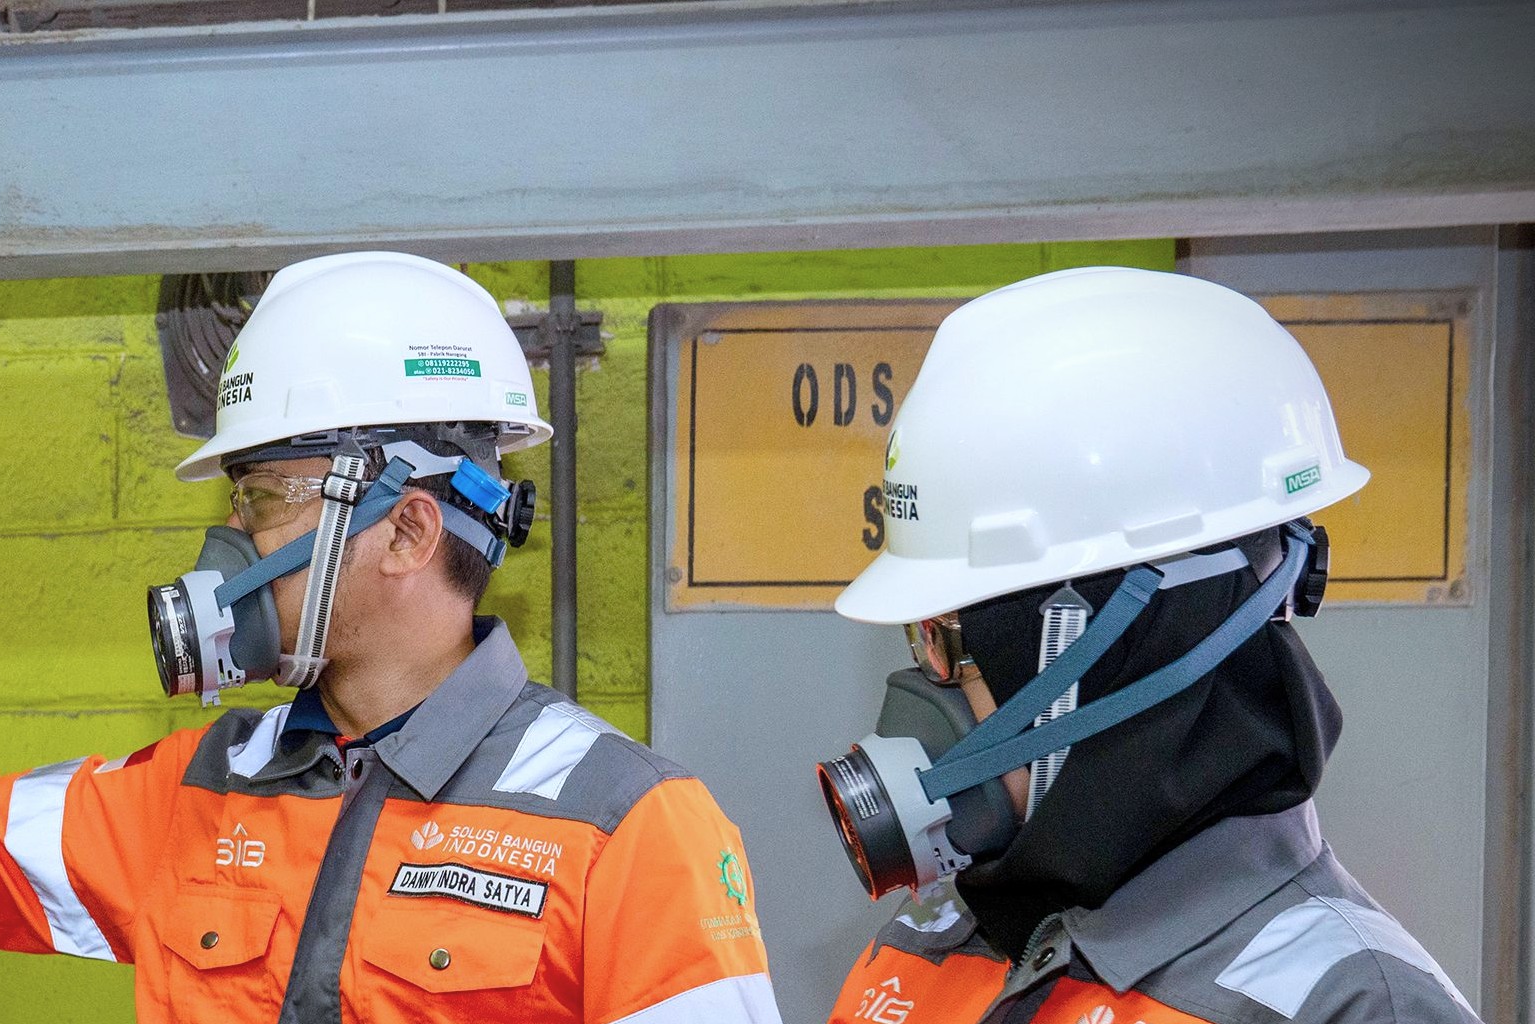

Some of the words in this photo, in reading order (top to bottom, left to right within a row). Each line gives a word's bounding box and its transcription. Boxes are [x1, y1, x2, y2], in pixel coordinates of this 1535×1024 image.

[507, 393, 527, 405] MSA
[792, 362, 894, 427] ODS
[1288, 468, 1321, 491] MSA
[862, 485, 885, 550] S
[884, 496, 919, 520] NESIA
[442, 838, 556, 877] INDONESIA
[450, 826, 500, 844] SOLUSI
[502, 834, 563, 859] BANGUN
[400, 870, 438, 889] DANNY
[437, 870, 476, 896] INDRA
[484, 879, 531, 908] SATYA
